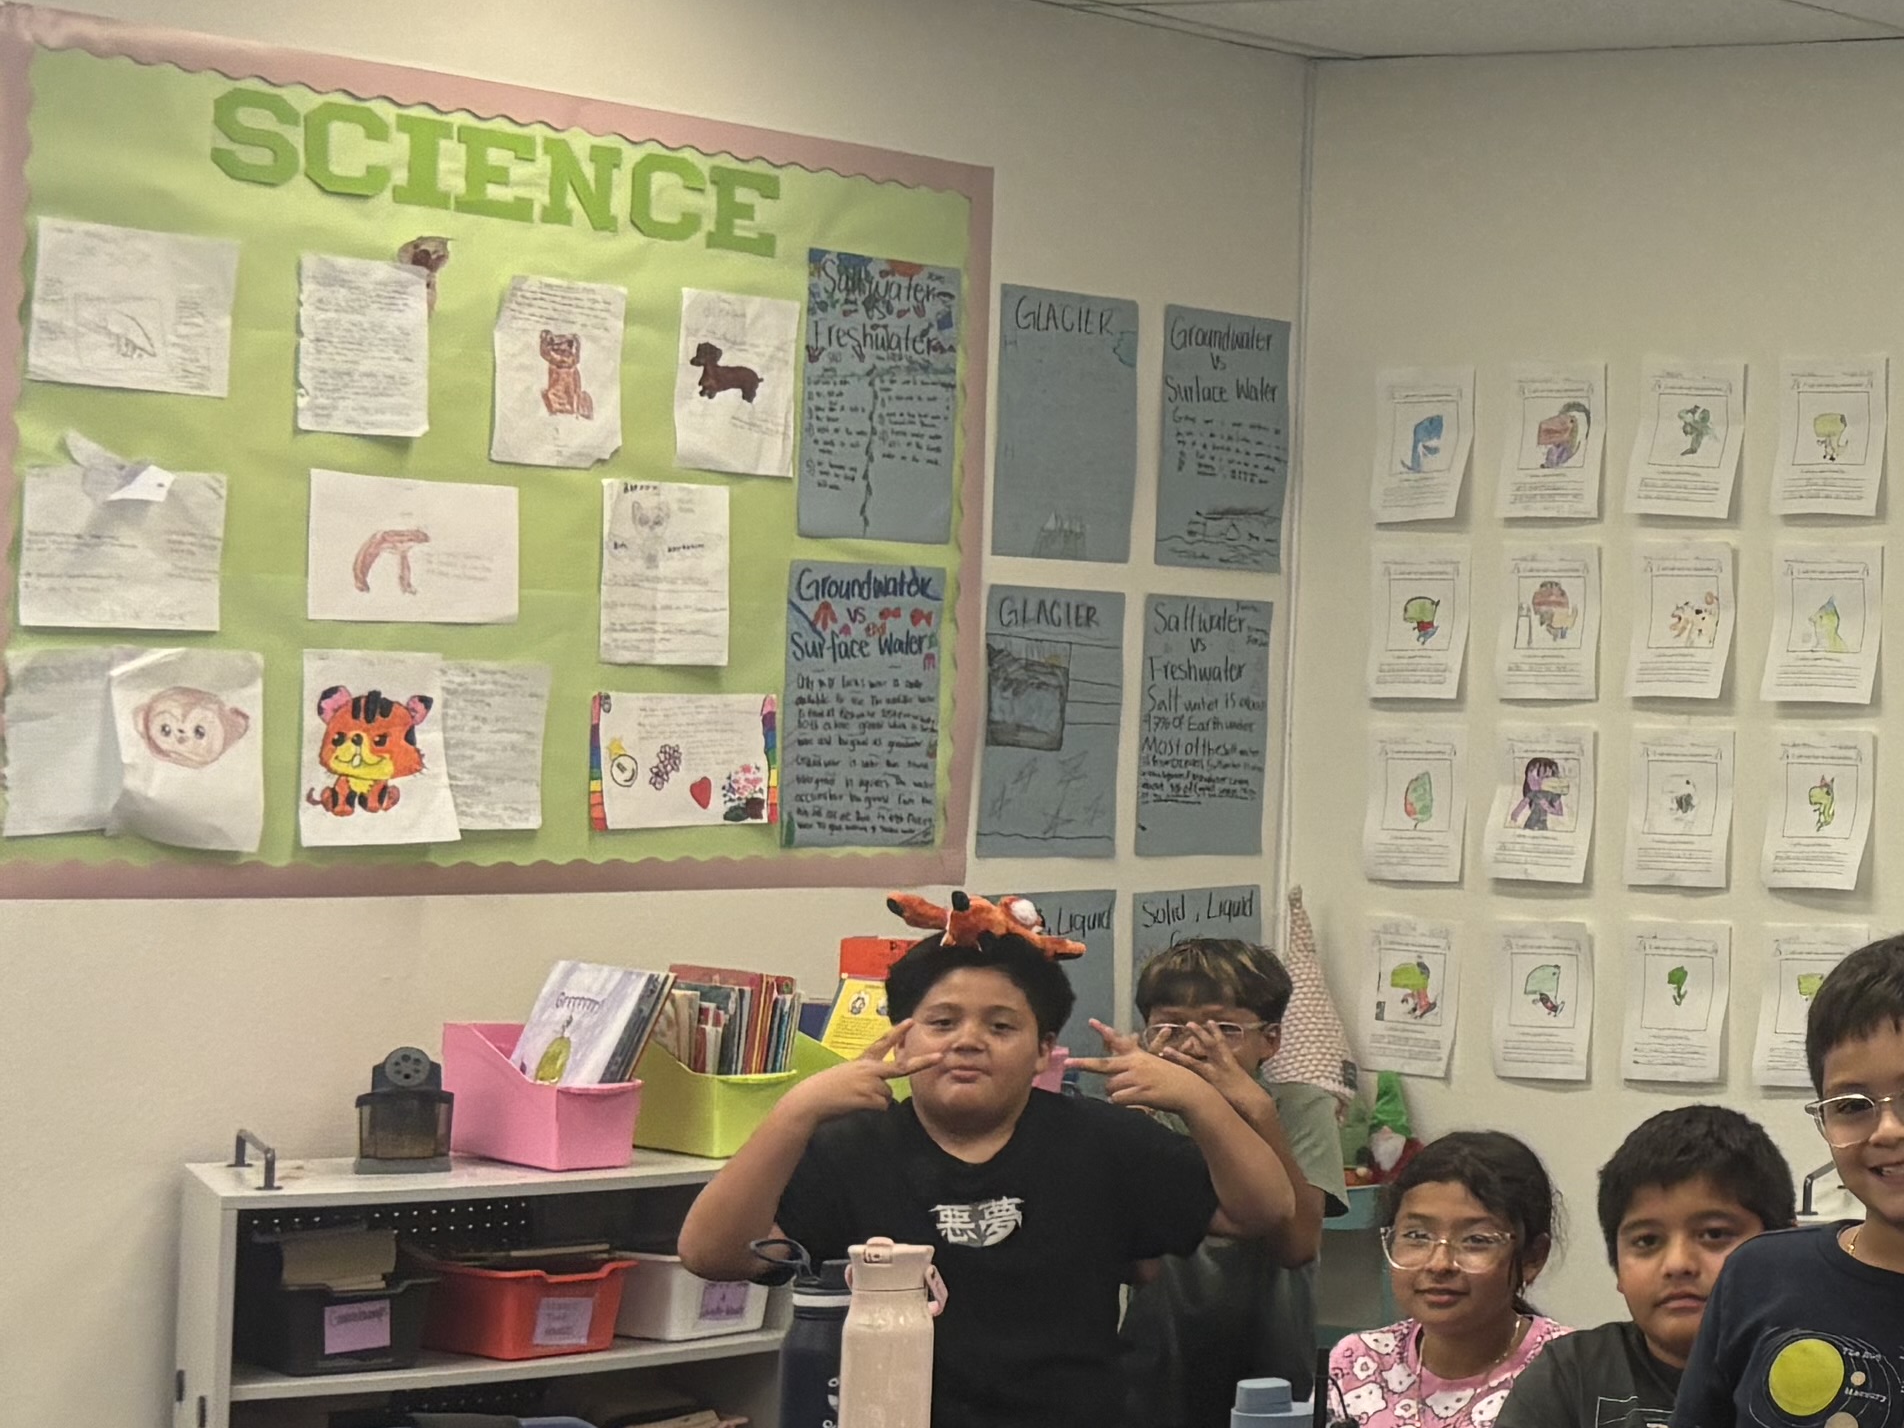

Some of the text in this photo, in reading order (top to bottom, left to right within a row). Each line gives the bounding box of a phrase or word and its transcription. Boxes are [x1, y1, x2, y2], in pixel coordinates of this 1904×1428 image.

[210, 87, 781, 258] SCIENCE
[1015, 295, 1113, 335] GLACIER
[1171, 316, 1273, 351] Groundwater
[1236, 378, 1276, 403] Water
[1000, 597, 1099, 628] GLACIER
[1154, 602, 1245, 634] Saltwater
[791, 629, 928, 664] Surface Water
[1149, 656, 1246, 682] Freshwater
[1207, 890, 1254, 921] Liquid
[1057, 907, 1114, 937] Liquid
